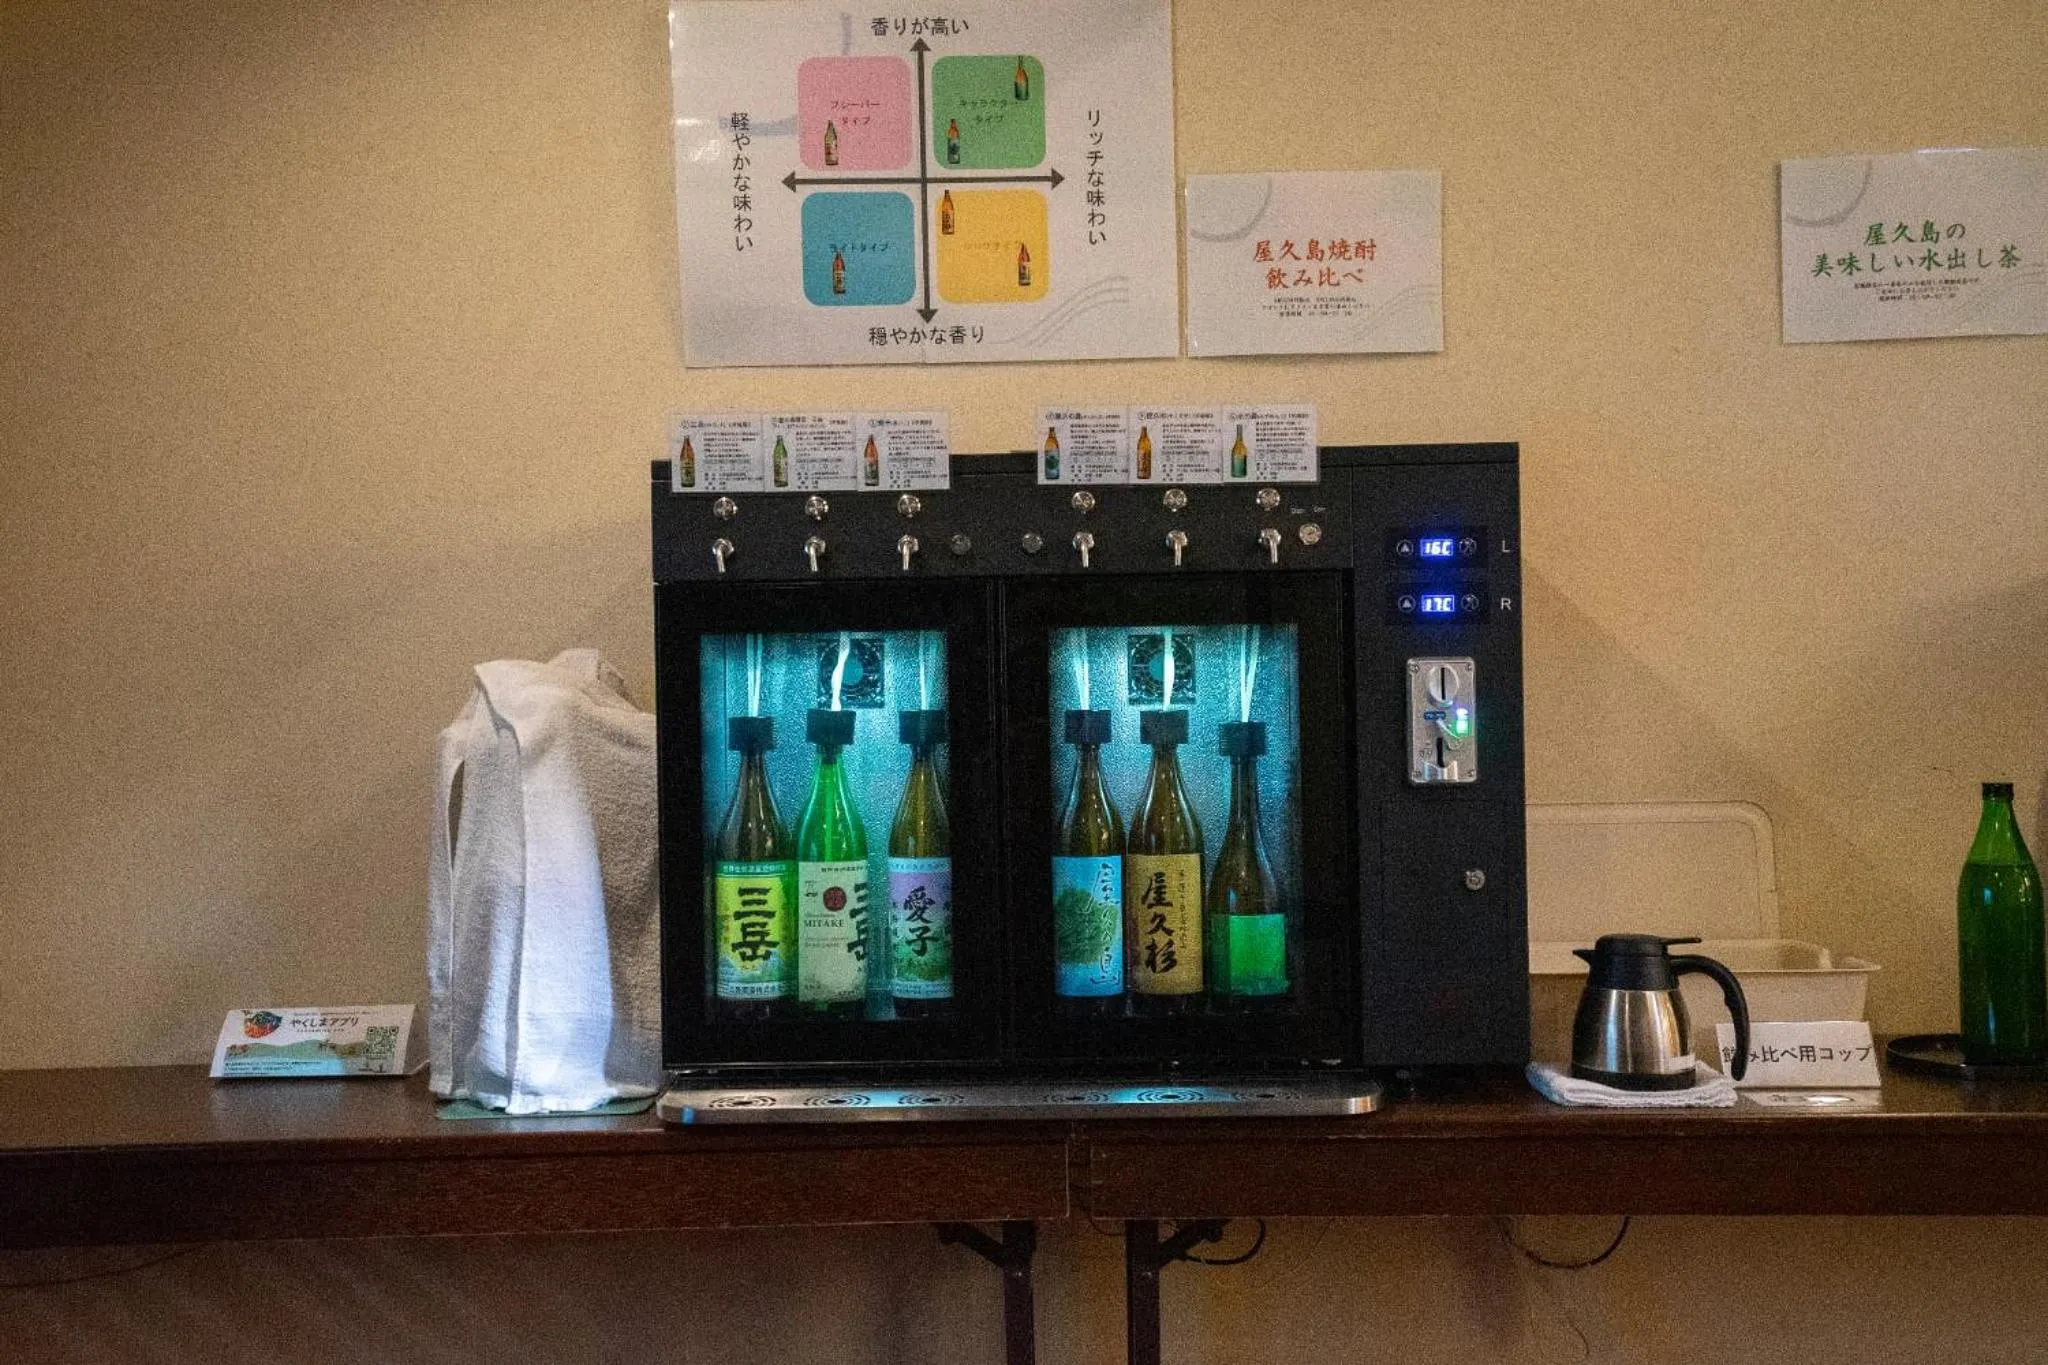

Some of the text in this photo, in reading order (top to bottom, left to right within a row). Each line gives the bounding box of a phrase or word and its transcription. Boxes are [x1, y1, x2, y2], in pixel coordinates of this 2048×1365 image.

[871, 16, 969, 36] 香りが高い
[731, 111, 753, 252] 軽やかな味わい
[1086, 109, 1107, 245] リッチな味わい
[1863, 219, 1966, 247] 屋久島の
[1253, 238, 1377, 263] 屋久島焼酎
[1811, 244, 2022, 278] 美味しい水出し茶
[1266, 266, 1363, 289] 飲み比べ
[869, 326, 984, 346] 穏やかな香り
[1501, 540, 1511, 553] L
[1500, 597, 1512, 611] R
[731, 887, 780, 961] 三岳
[803, 919, 845, 928] MITAKE
[904, 886, 940, 957] 愛子
[1141, 871, 1178, 973] 屋久杉
[290, 1016, 359, 1029] やくしまアプリ
